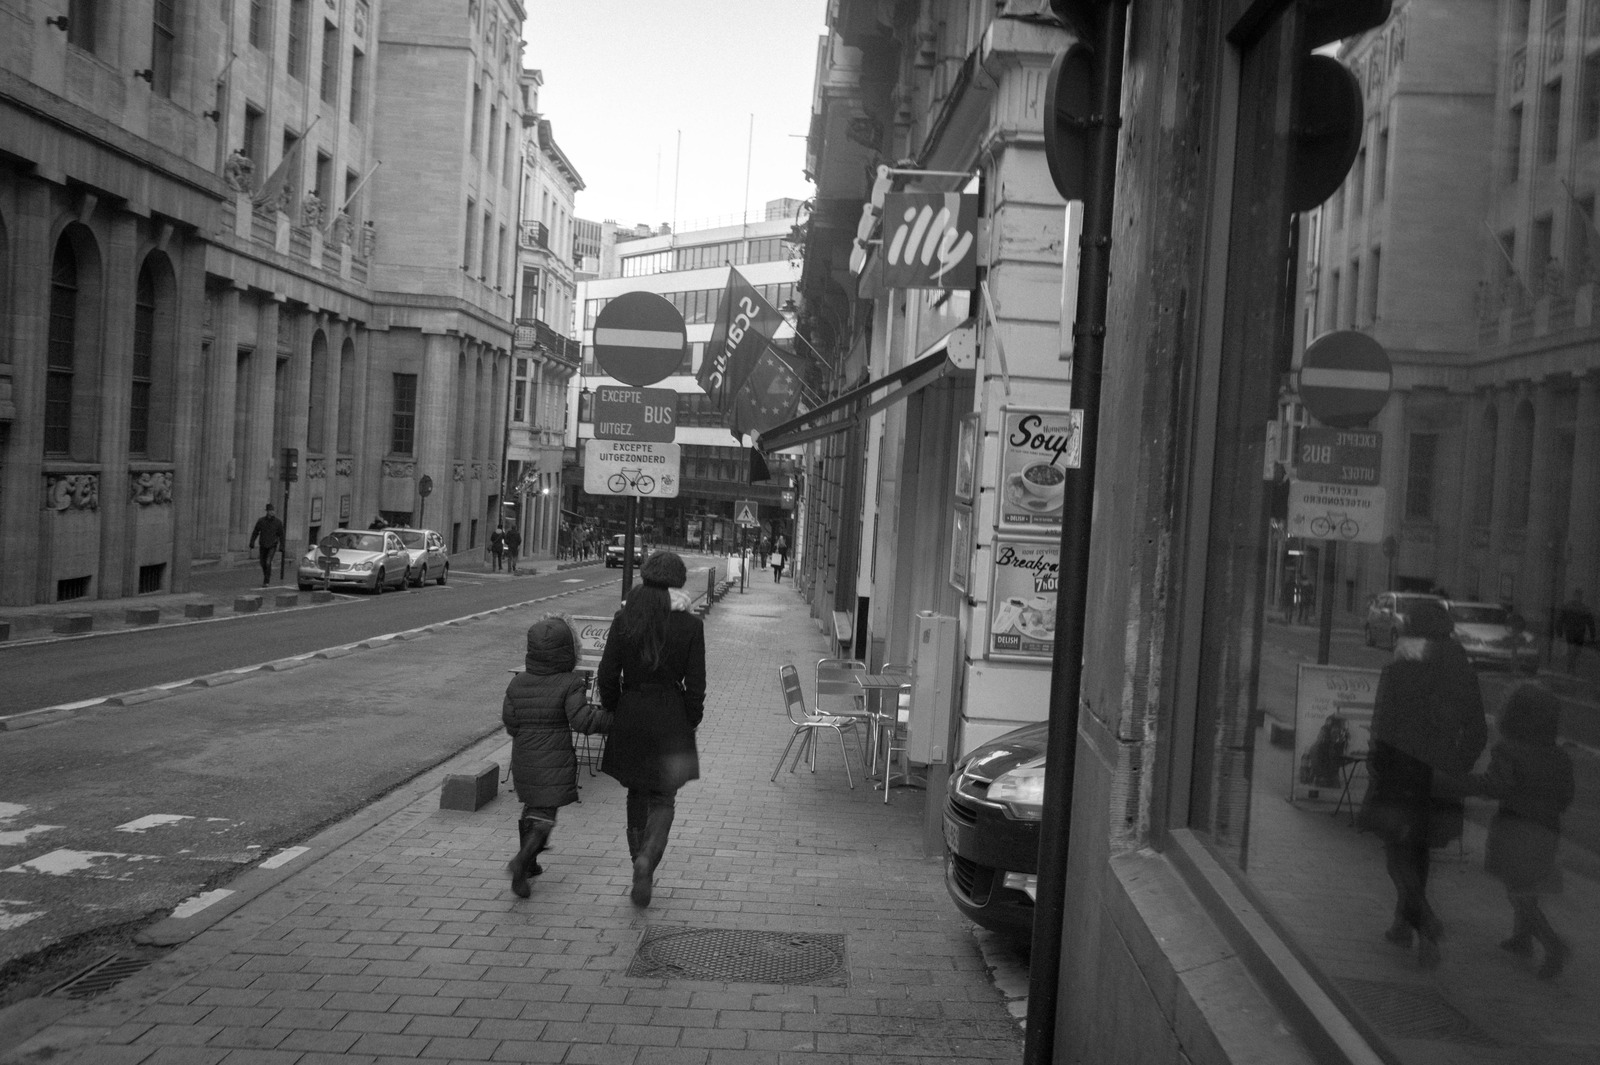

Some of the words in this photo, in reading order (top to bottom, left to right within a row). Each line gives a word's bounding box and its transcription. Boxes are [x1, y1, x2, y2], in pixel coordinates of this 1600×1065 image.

[887, 204, 973, 280] illy
[601, 390, 642, 404] EXCEPTE
[644, 406, 672, 424] BUS
[613, 443, 653, 453] EXCEPTE
[599, 452, 666, 464] UITGEZONDERD
[995, 547, 1059, 577] Breakfa
[581, 624, 611, 640] Coca-C
[997, 636, 1018, 644] DELISH
